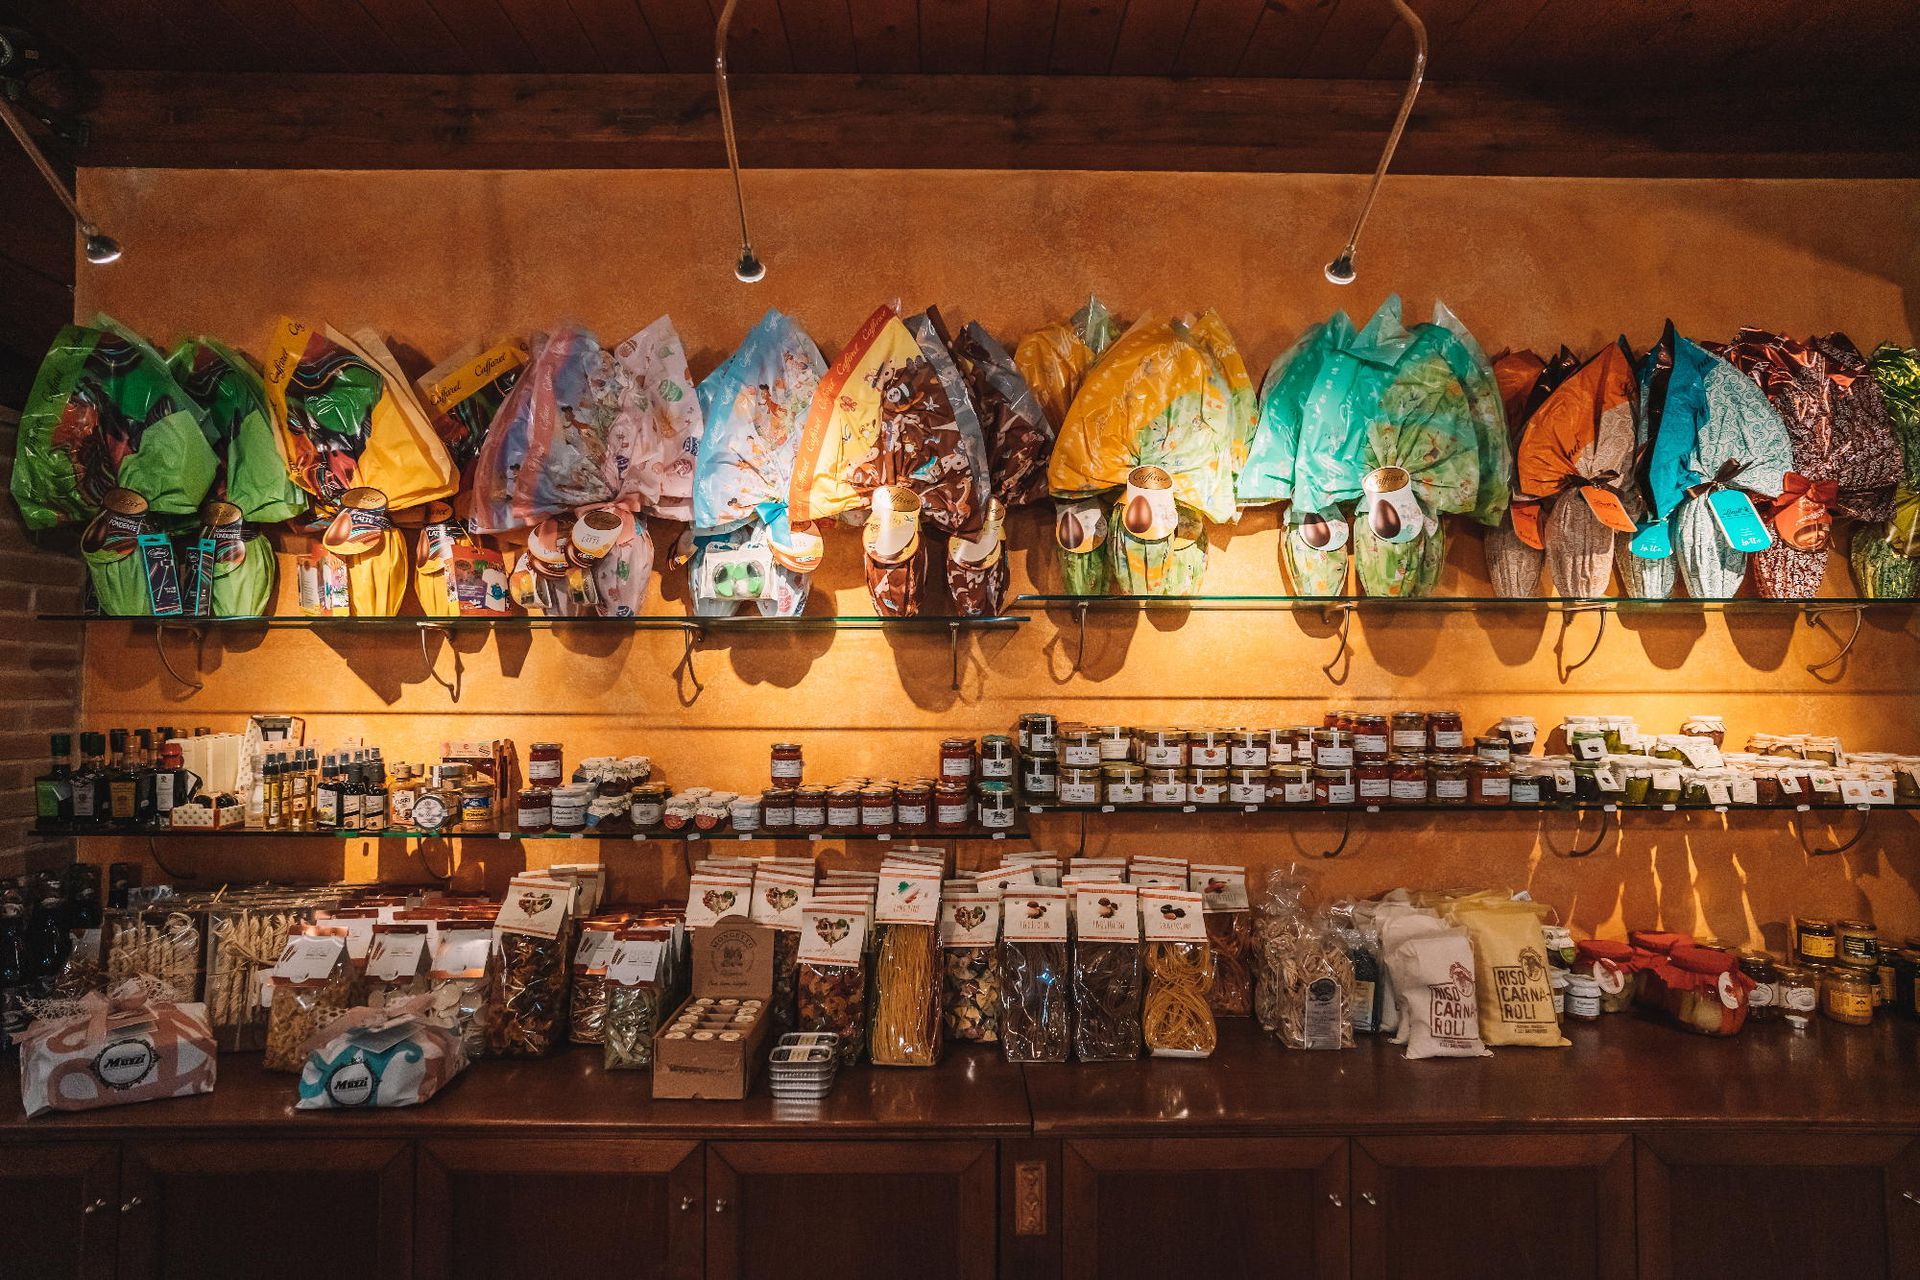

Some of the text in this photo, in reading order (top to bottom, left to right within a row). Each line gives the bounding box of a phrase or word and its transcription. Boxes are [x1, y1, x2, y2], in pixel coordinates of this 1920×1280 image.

[1497, 969, 1527, 986] RISO
[1433, 985, 1461, 1002] RISO
[1503, 1003, 1537, 1020] ROLI
[1434, 1017, 1466, 1037] ROLI
